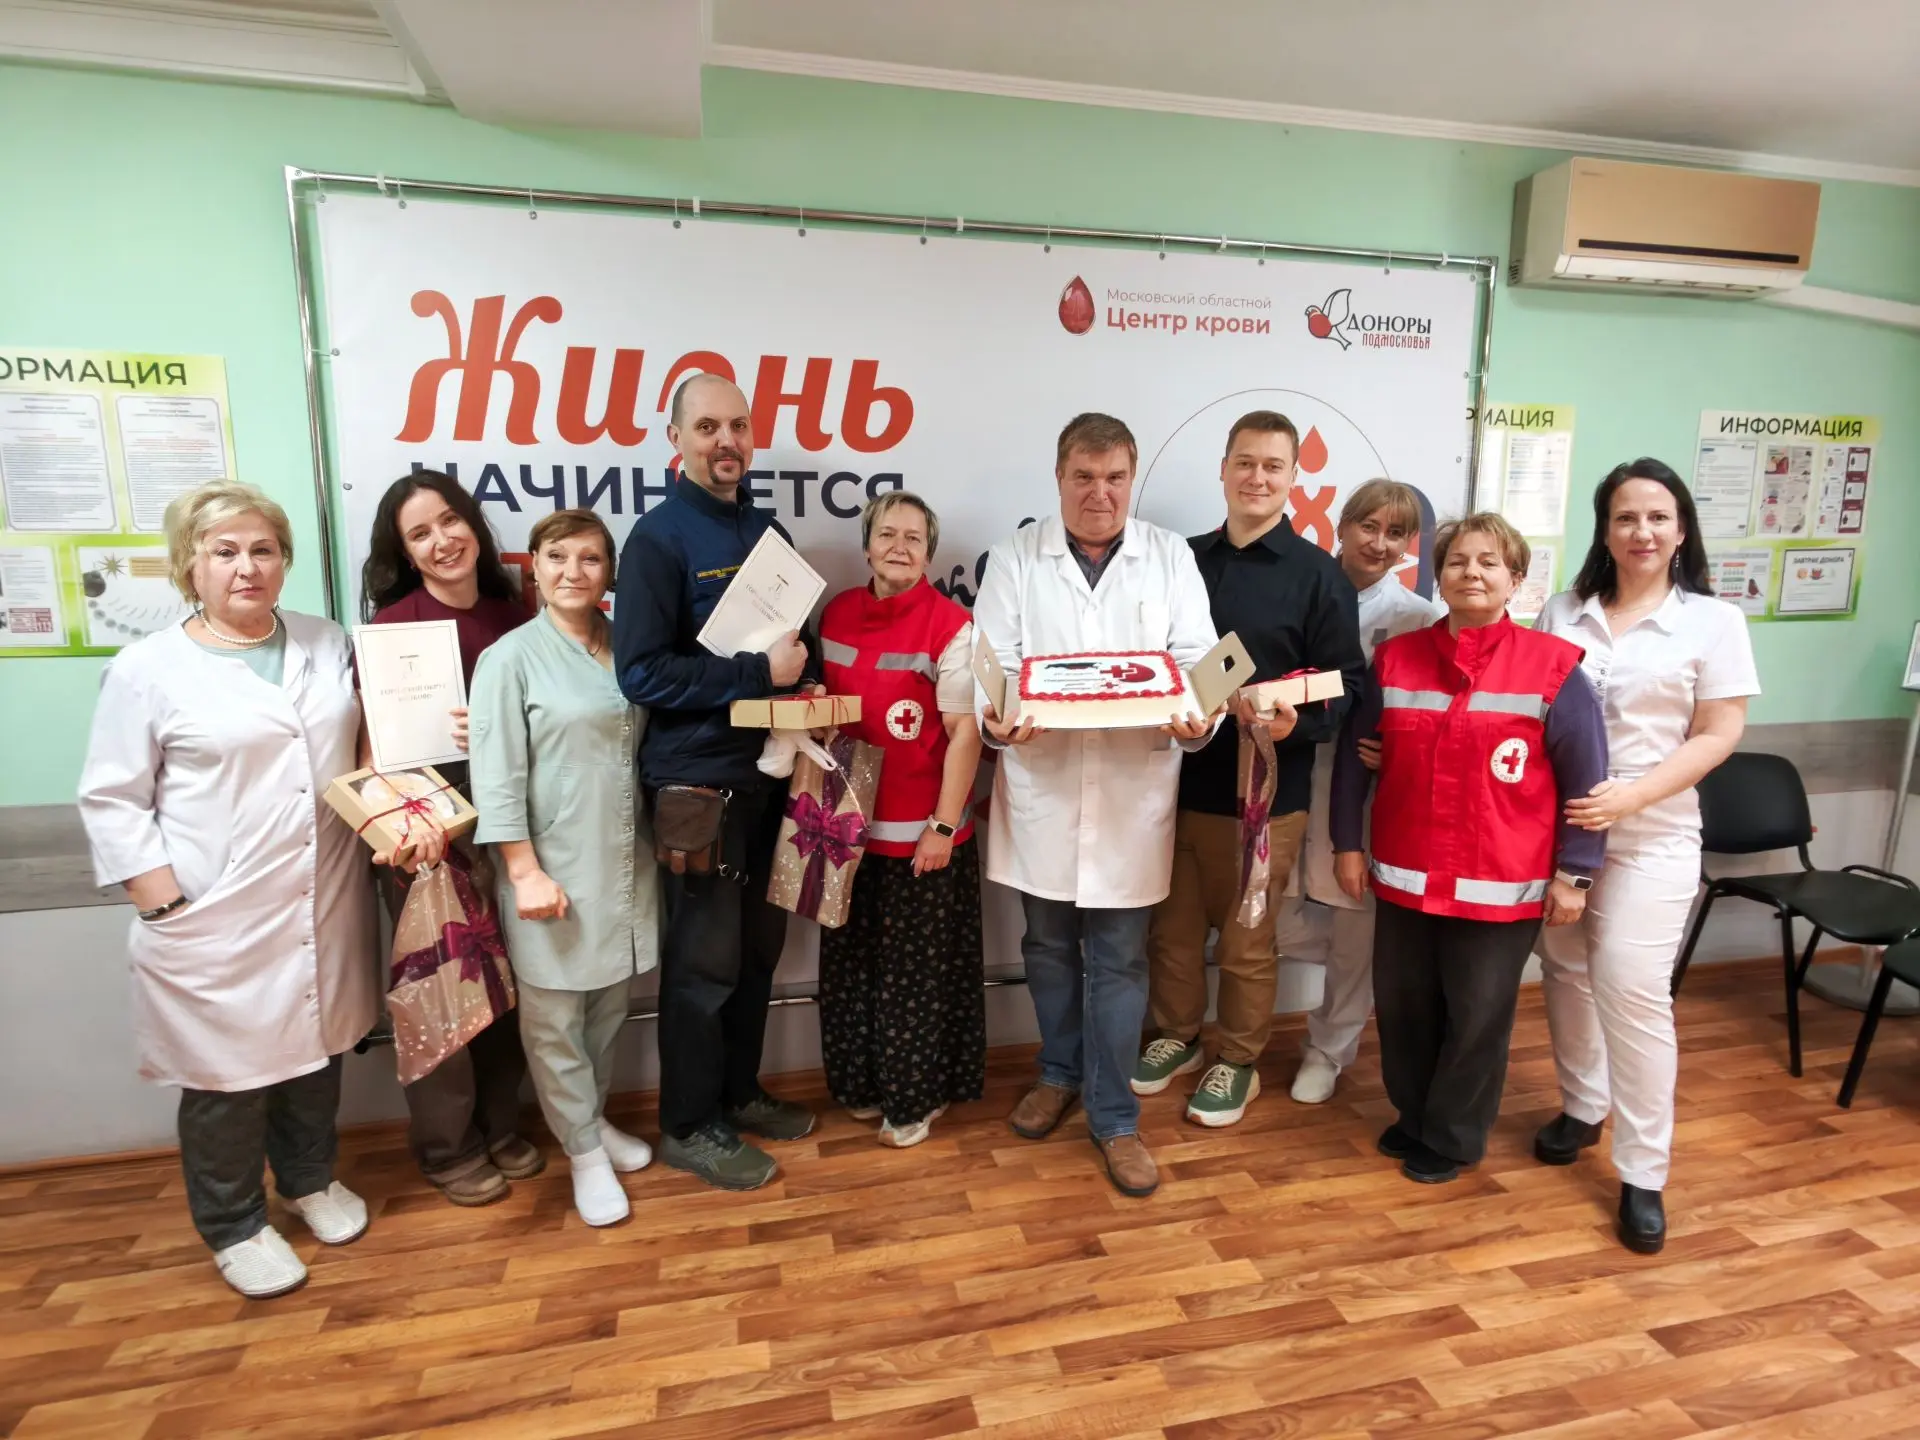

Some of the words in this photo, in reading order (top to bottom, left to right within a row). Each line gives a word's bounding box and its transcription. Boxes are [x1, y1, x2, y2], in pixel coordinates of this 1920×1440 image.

[1107, 288, 1195, 305] Московский
[1199, 293, 1272, 309] областной
[1107, 307, 1188, 336] Центр
[1195, 315, 1271, 337] крови
[1346, 313, 1431, 334] ДОНОРЫ
[1362, 333, 1431, 350] ПОДМОСКОВЬЯ
[1720, 416, 1863, 439] ИНФОРМАЦИЯ
[411, 461, 903, 519] АЧИНЕТСЯ
